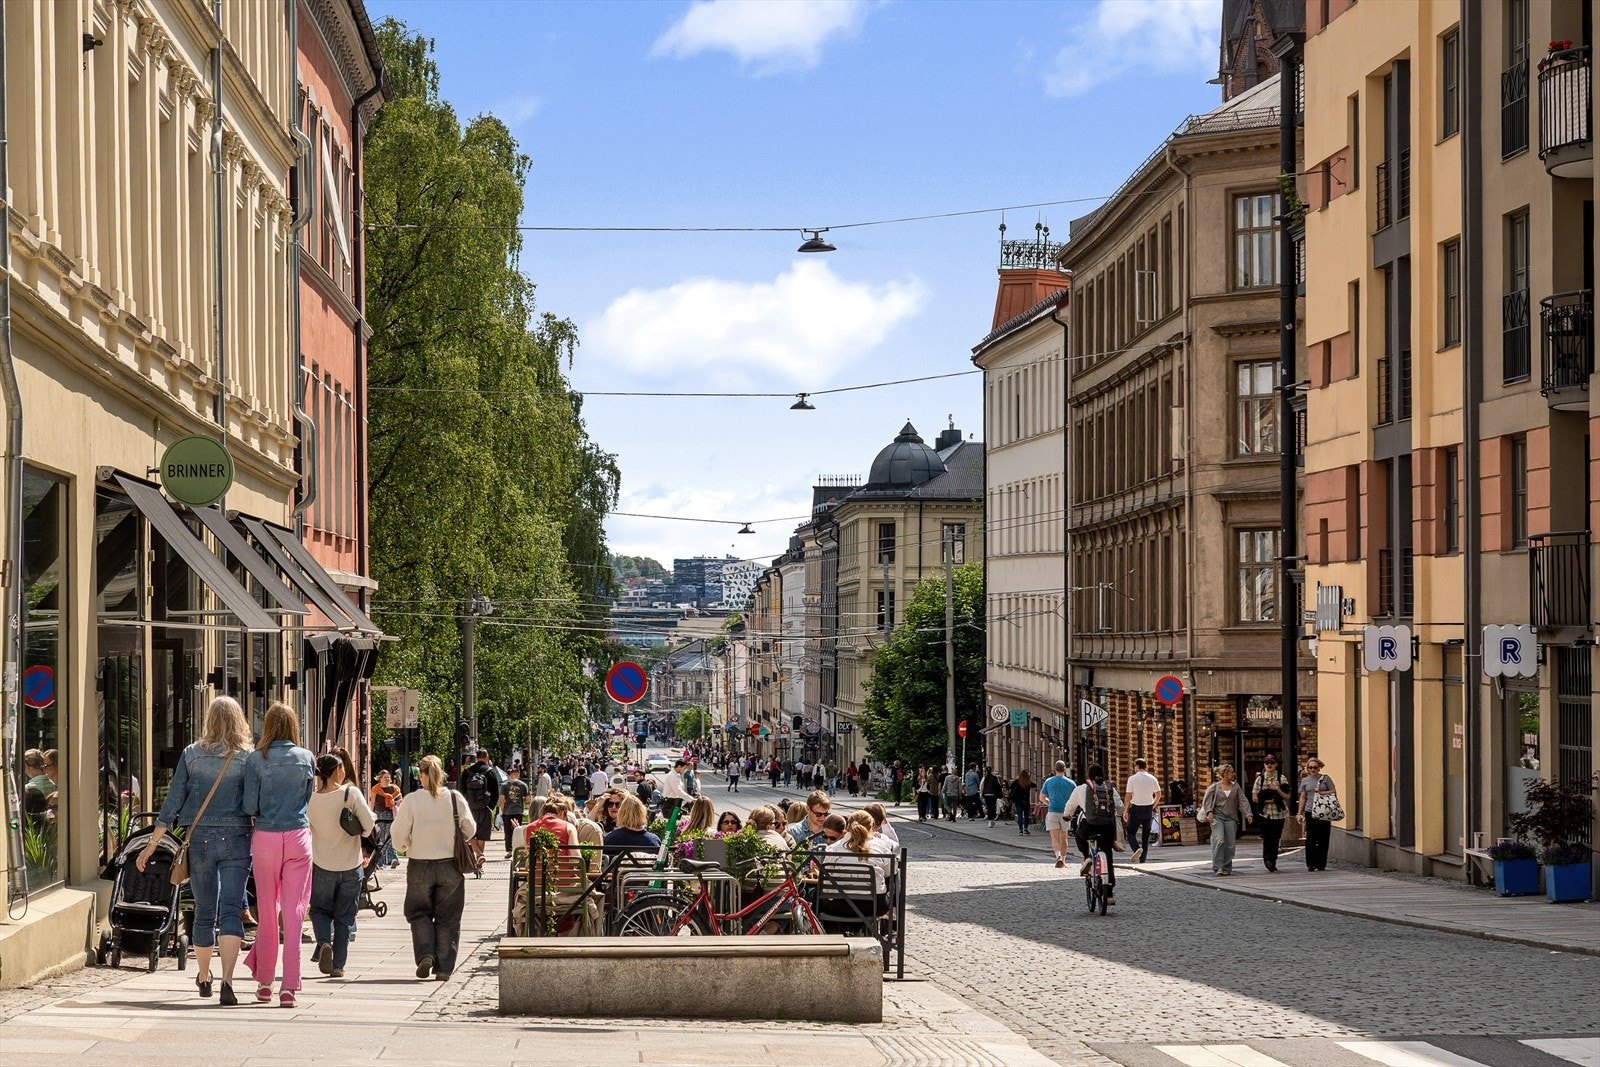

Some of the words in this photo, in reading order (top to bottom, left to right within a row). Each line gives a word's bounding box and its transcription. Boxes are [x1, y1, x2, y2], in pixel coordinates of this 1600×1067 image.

[168, 464, 225, 478] BRINNER
[1379, 637, 1397, 660] R
[1500, 638, 1522, 664] R
[1084, 702, 1103, 726] BAR
